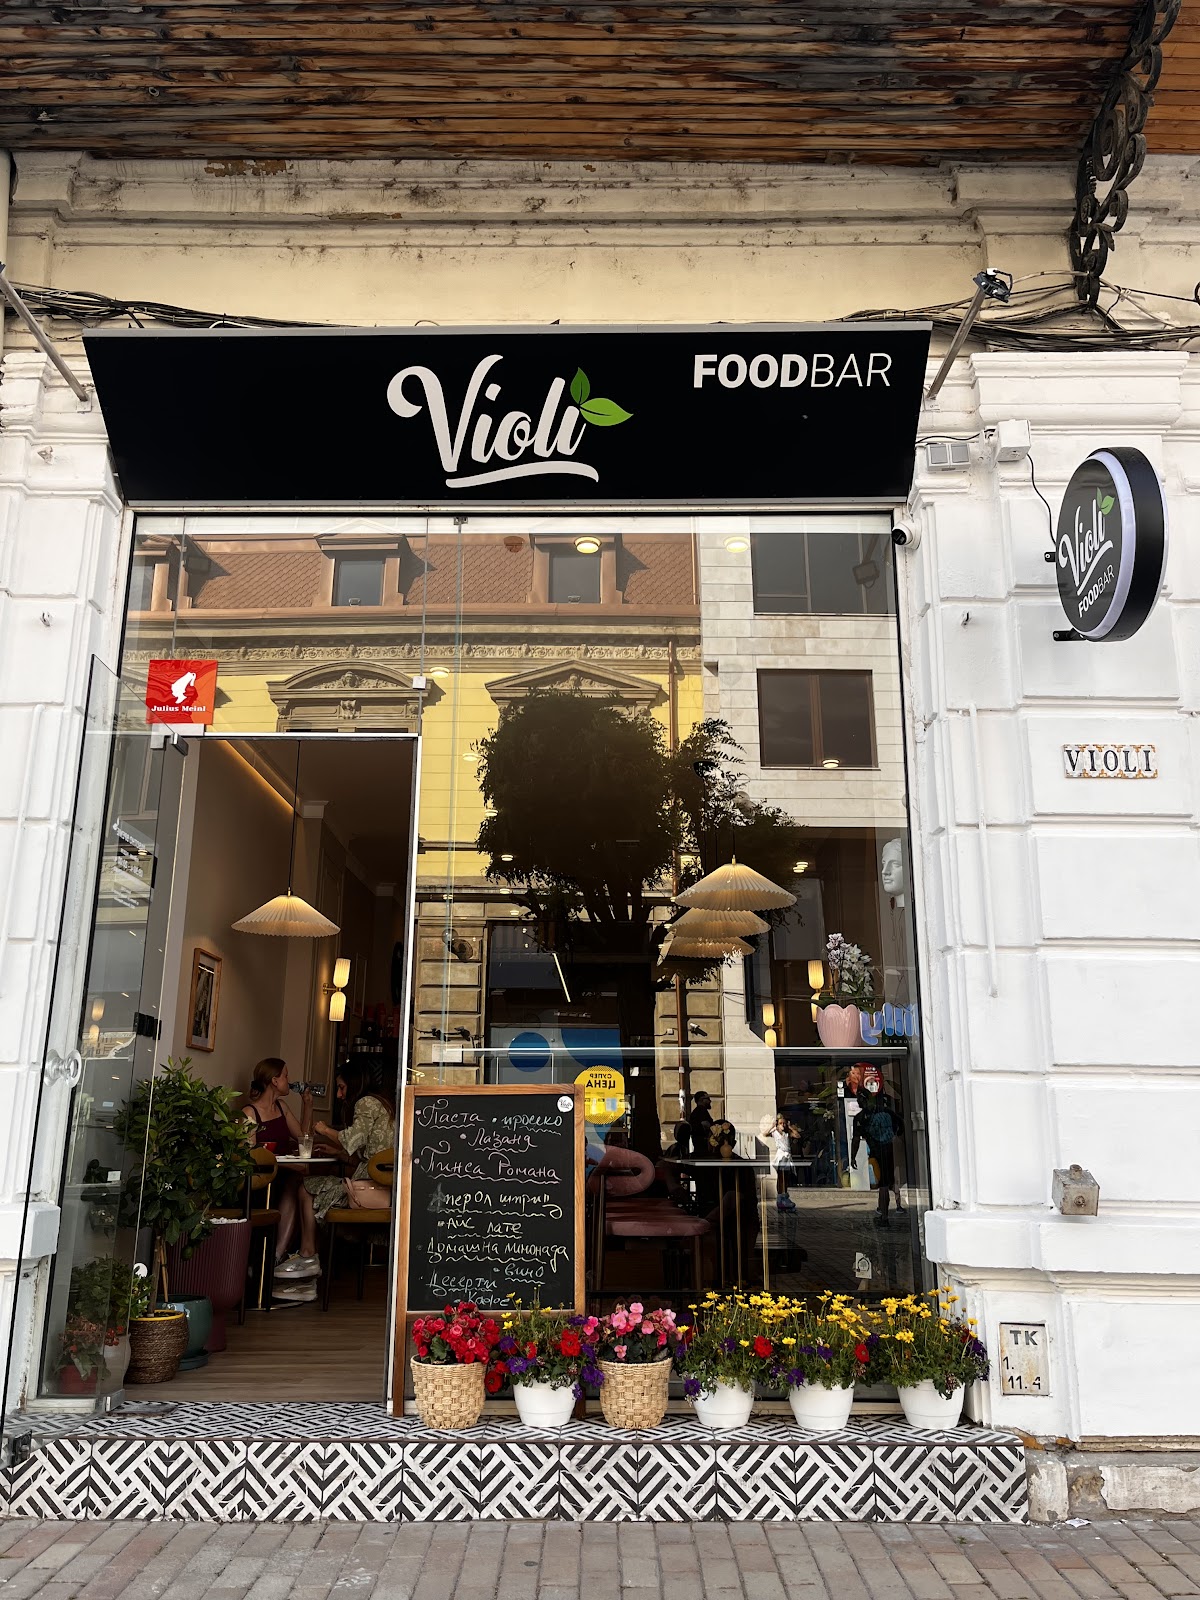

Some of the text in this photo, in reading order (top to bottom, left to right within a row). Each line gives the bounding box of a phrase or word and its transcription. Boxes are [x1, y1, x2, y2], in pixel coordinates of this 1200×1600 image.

[387, 354, 587, 473] Violi
[1058, 498, 1106, 587] Violi
[1065, 749, 1152, 773] VIOLI
[418, 1098, 485, 1127] Паста
[468, 1127, 538, 1152] Лазаня
[420, 1140, 562, 1181] Пинса Романа
